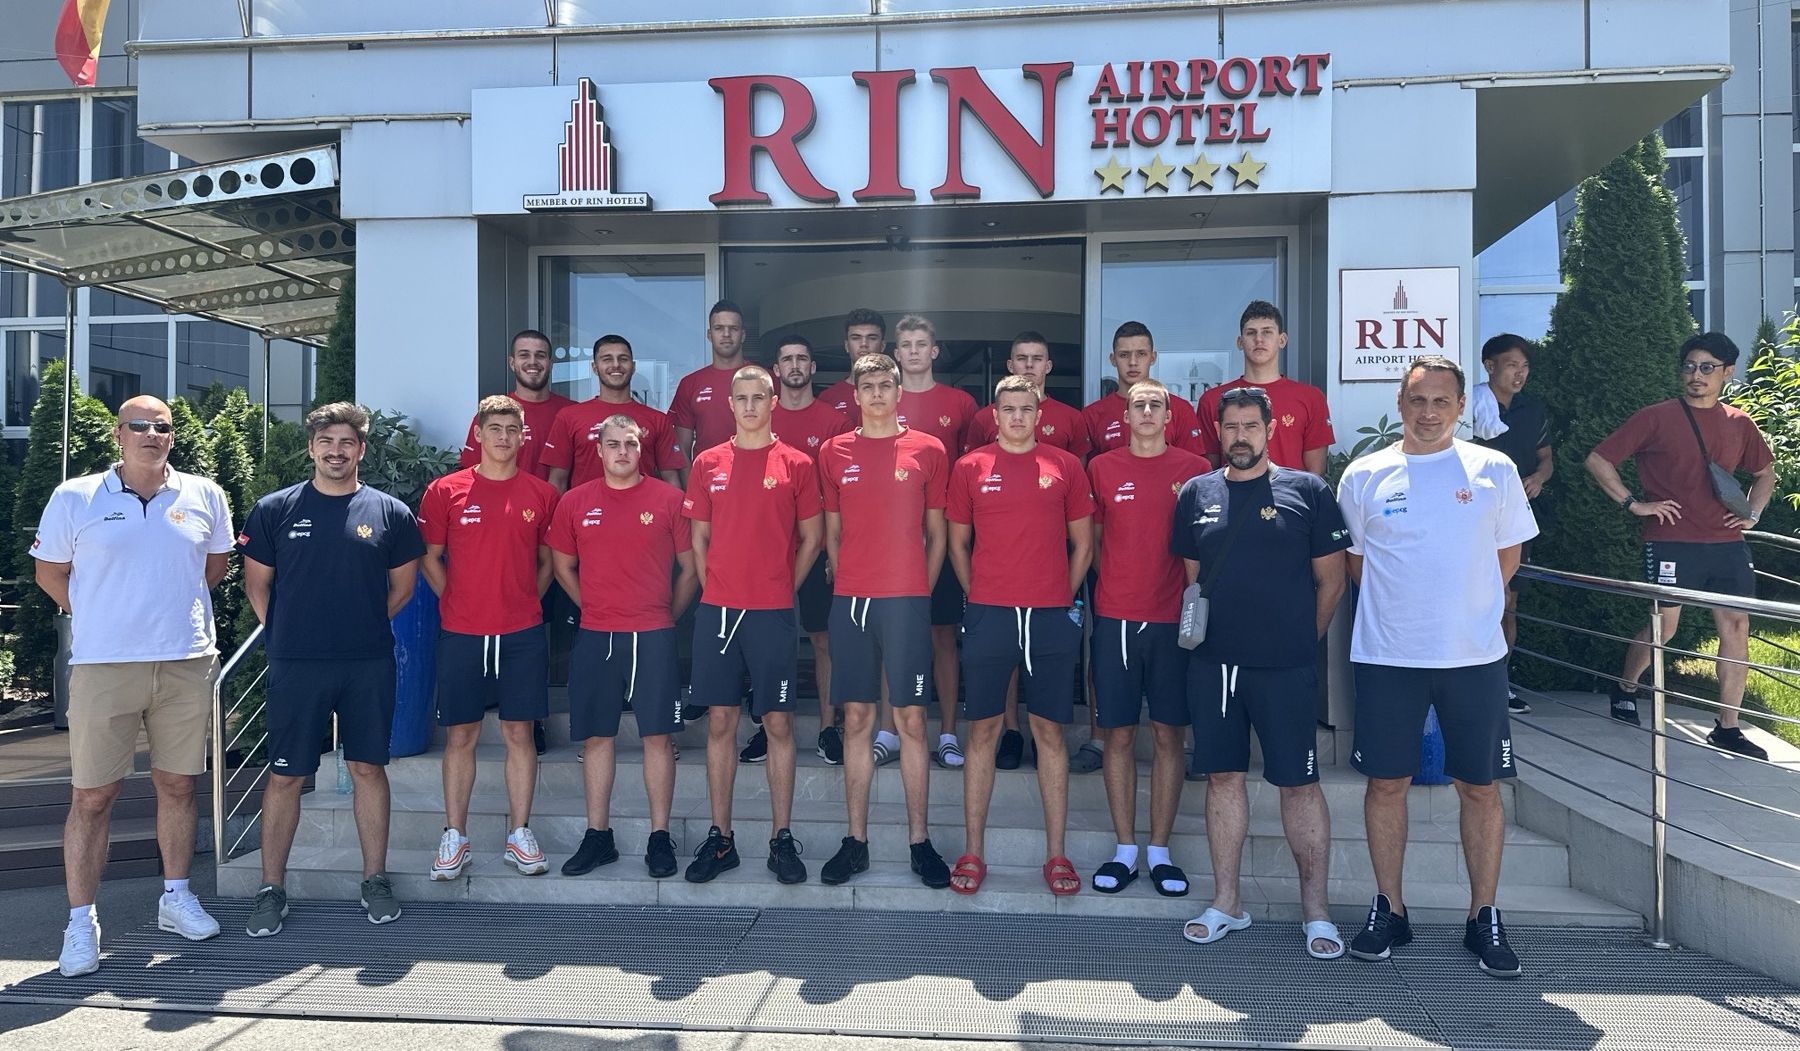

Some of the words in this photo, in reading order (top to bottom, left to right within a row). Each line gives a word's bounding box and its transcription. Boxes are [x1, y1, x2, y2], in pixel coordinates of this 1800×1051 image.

[1088, 53, 1331, 104] AIRPORT
[707, 61, 1075, 204] RIN
[1090, 102, 1272, 149] HOTEL
[526, 198, 568, 207] MEMBER
[586, 197, 603, 205] RIN
[606, 196, 645, 205] HOTELS
[1355, 317, 1448, 350] RIN
[1355, 355, 1405, 364] AIRPORT
[779, 680, 789, 702] MNE
[915, 674, 924, 696] MNE
[674, 700, 682, 724] MNE
[1306, 749, 1314, 775] MNE
[1502, 739, 1511, 768] MNE
